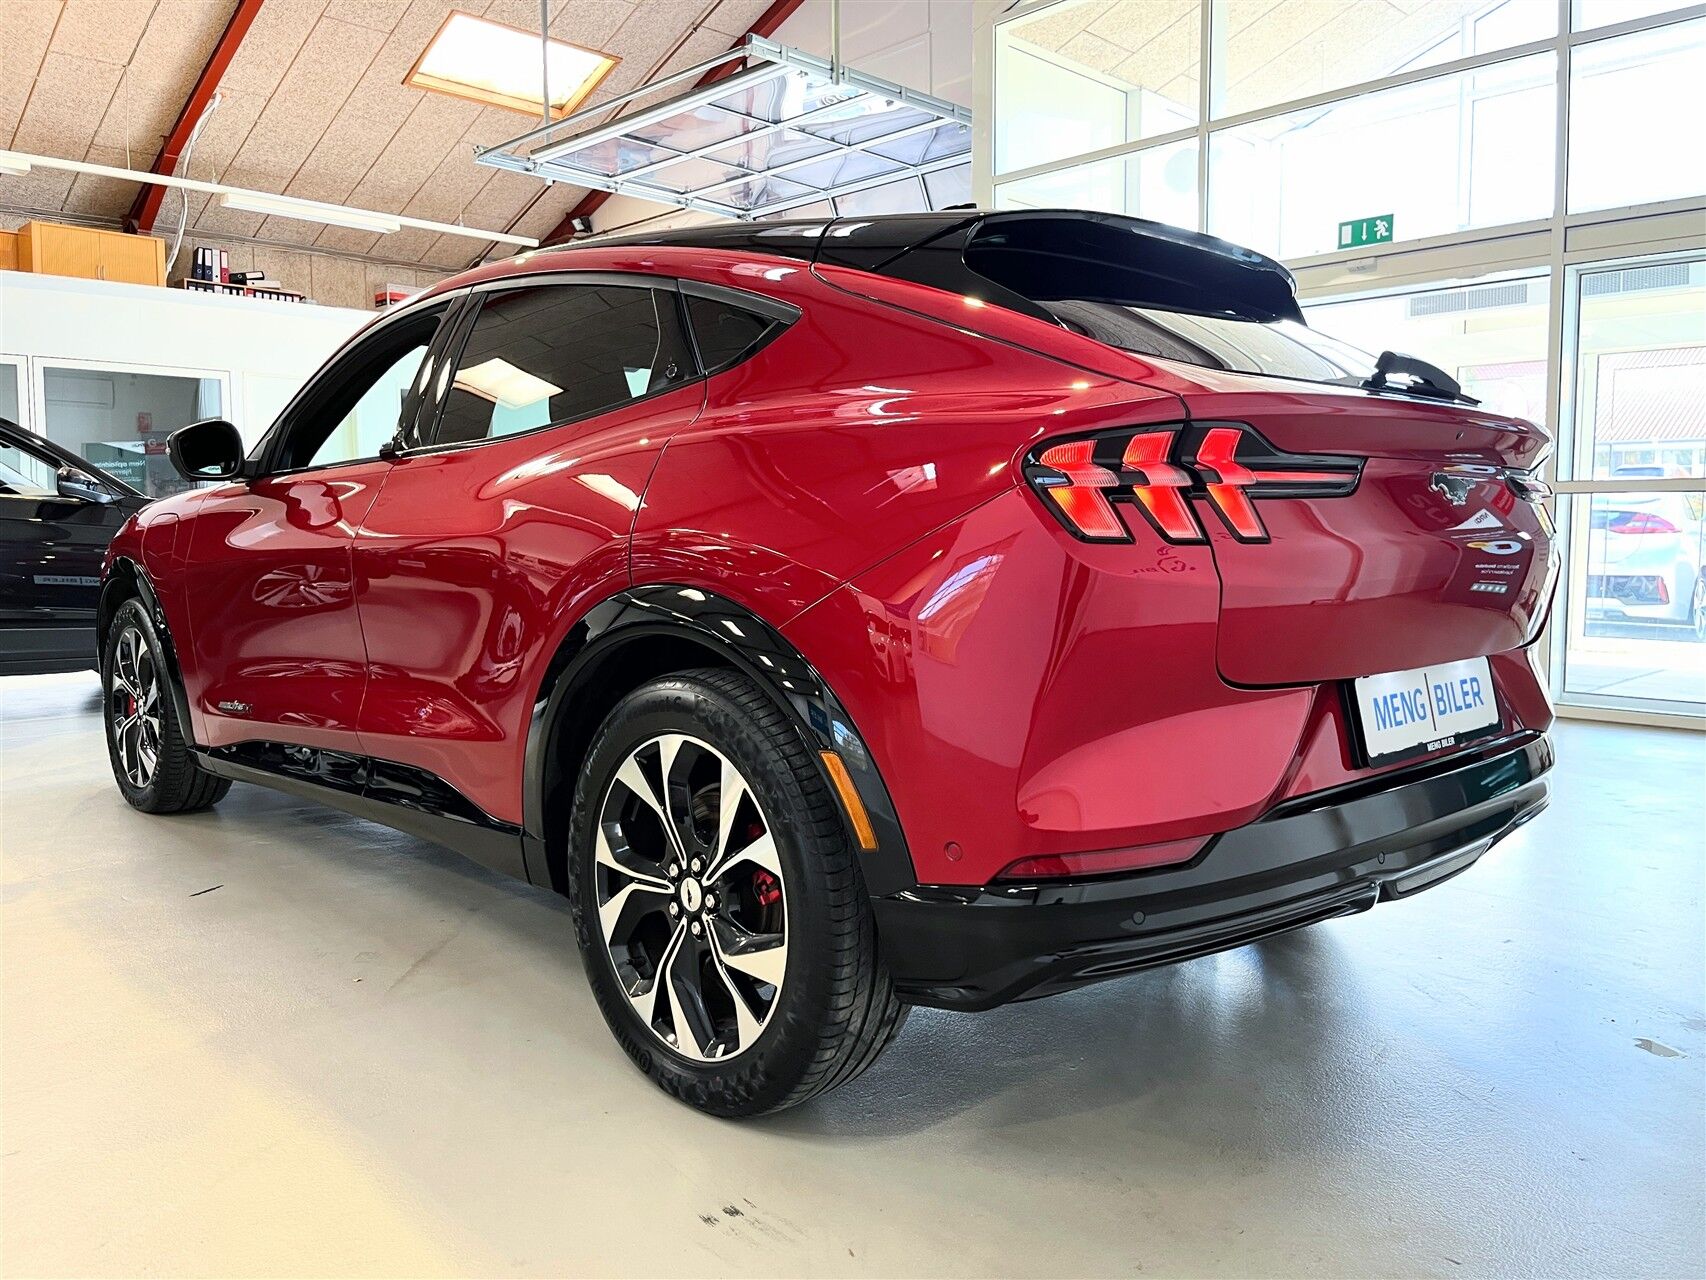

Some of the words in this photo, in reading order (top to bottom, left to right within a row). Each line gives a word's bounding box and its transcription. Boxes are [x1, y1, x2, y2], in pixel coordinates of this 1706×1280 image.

[1373, 688, 1427, 731] MENG
[1433, 676, 1484, 716] BILER
[1426, 740, 1442, 752] MENG
[1441, 736, 1456, 749] BILER
